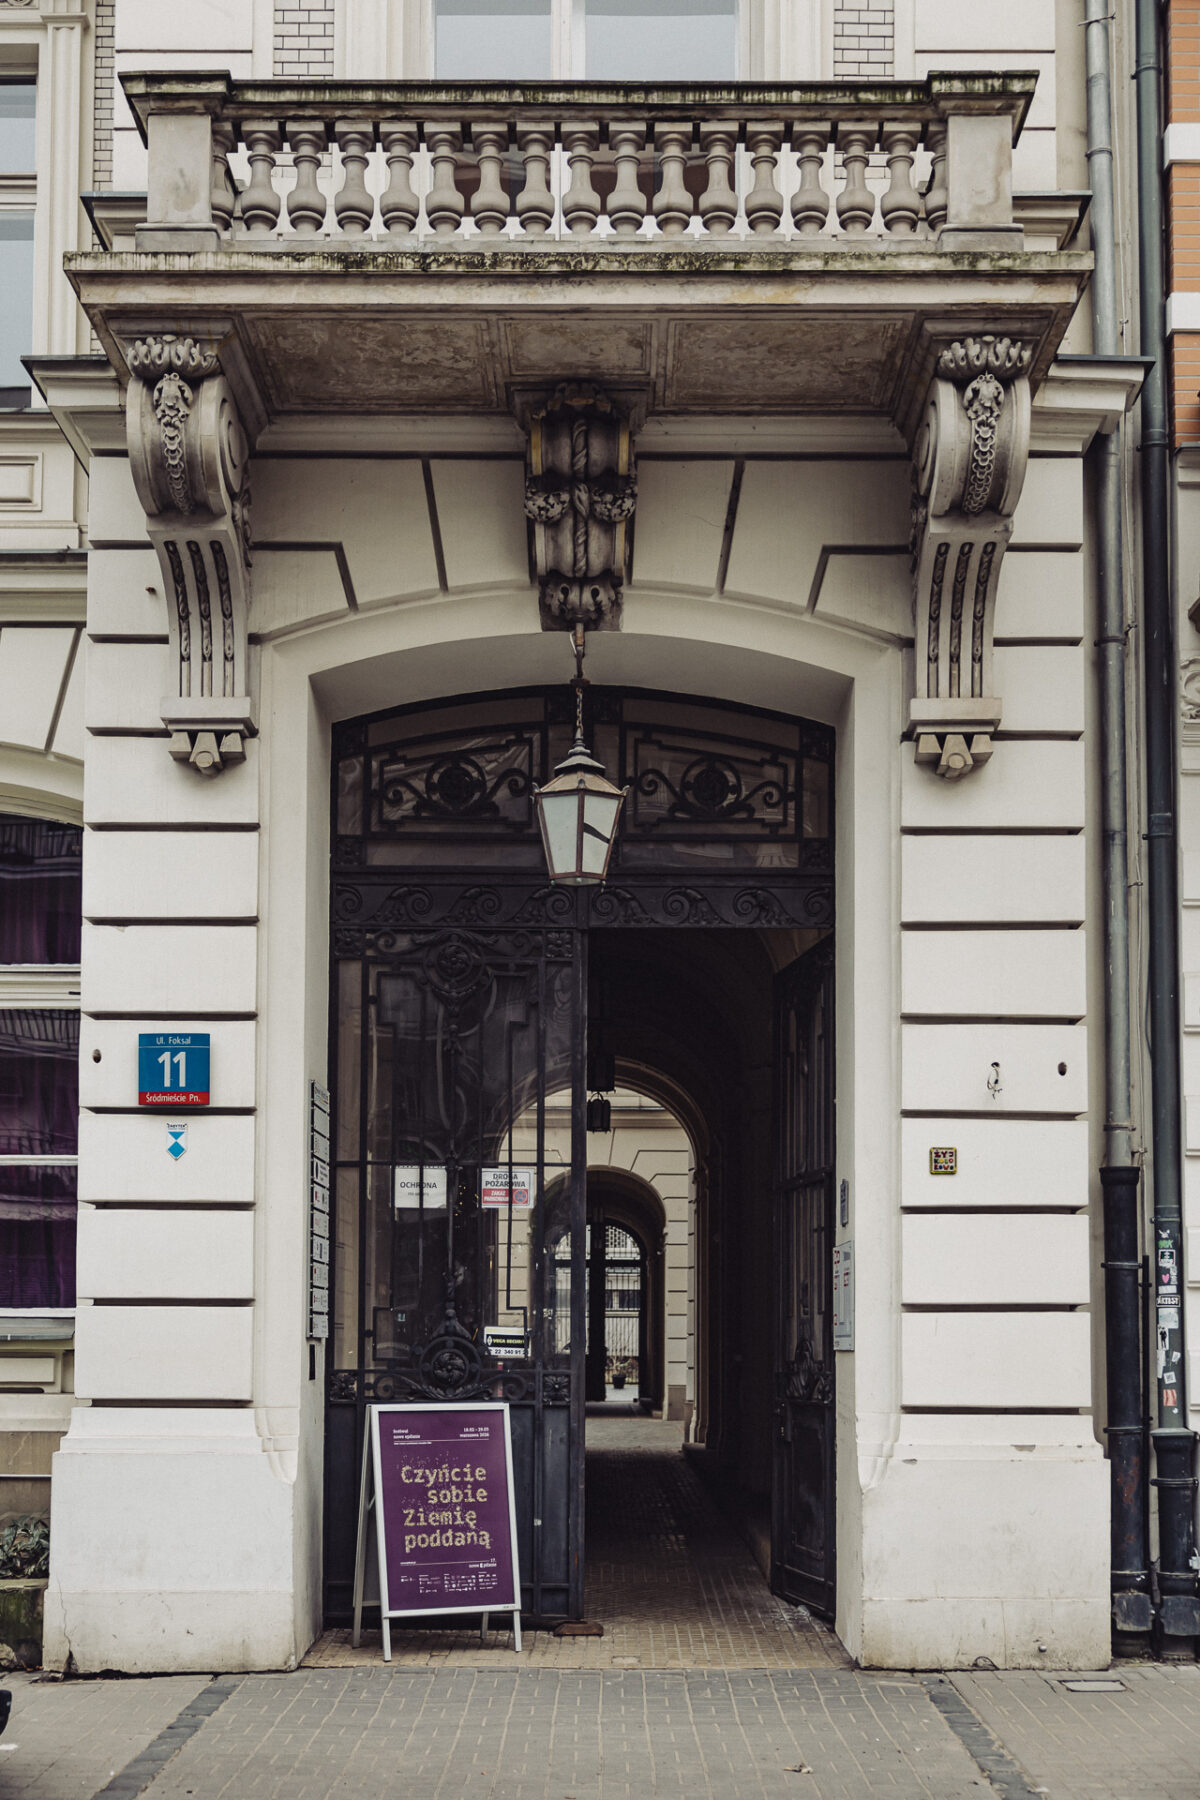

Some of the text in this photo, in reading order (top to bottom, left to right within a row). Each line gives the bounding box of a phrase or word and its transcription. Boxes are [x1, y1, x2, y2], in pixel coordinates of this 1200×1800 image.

[168, 1036, 191, 1044] Foksal
[157, 1051, 186, 1087] 11
[146, 1092, 201, 1102] Śródmieście Pn.
[401, 1463, 487, 1487] Czyńcie
[427, 1484, 488, 1504] sobie
[403, 1506, 477, 1529] Ziemię
[404, 1529, 491, 1553] poddaną
